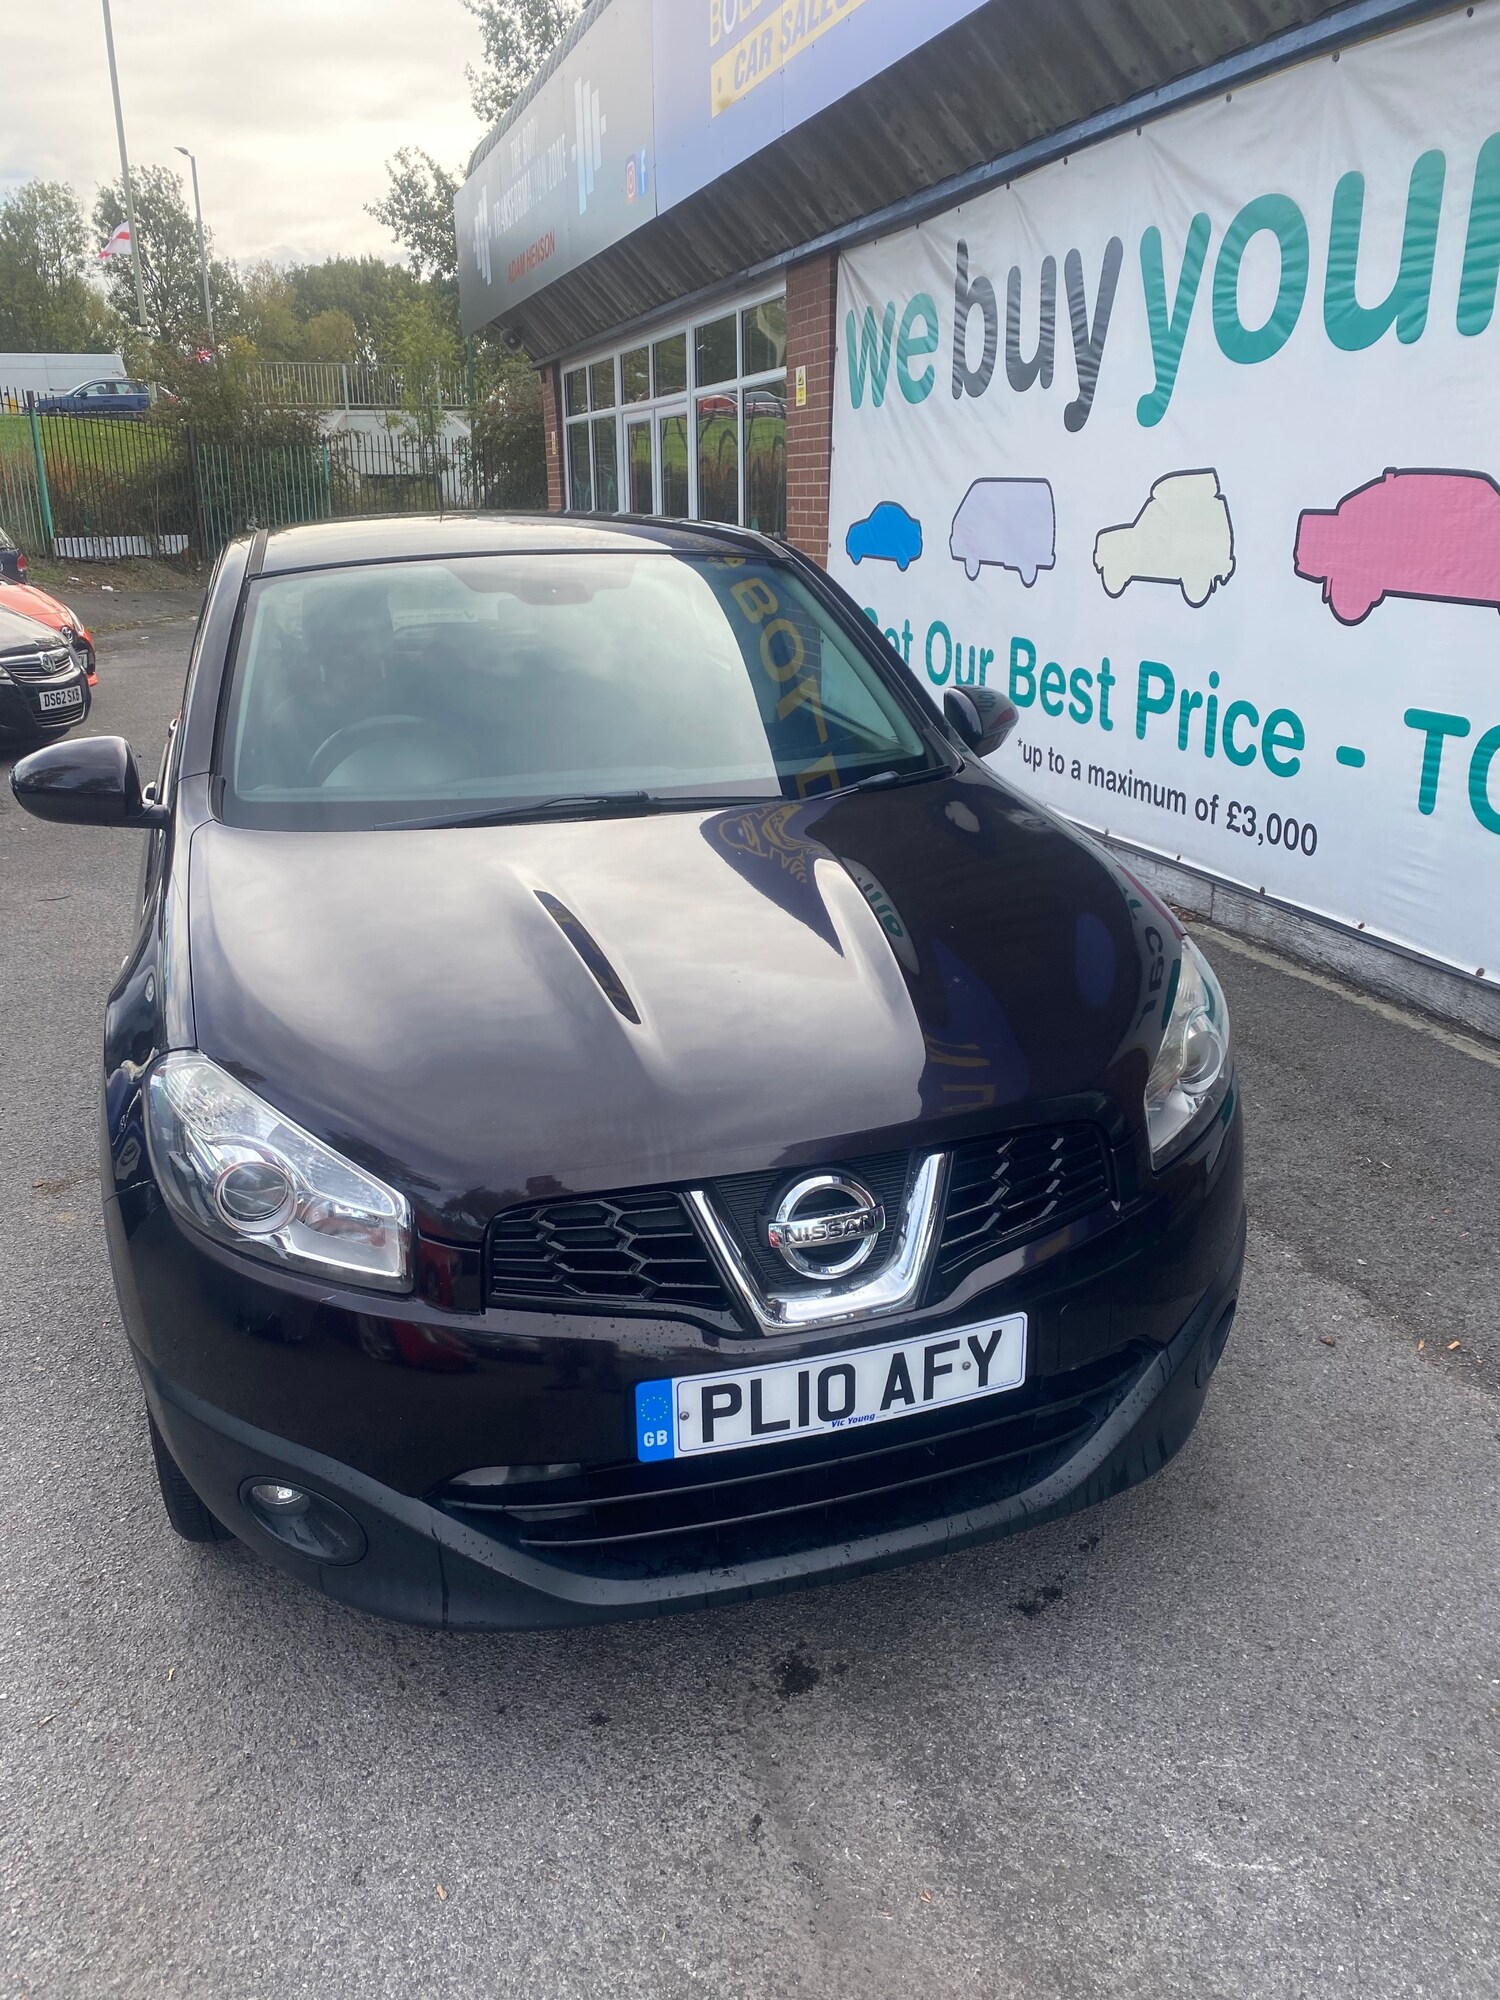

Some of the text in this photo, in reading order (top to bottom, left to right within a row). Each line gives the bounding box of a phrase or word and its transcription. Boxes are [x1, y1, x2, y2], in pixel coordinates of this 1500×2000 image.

[734, 0, 850, 90] CAR SALE
[510, 132, 522, 178] THE
[493, 133, 567, 240] TRANSFORMATION ZONE
[507, 228, 556, 285] ADAM HENSON
[43, 690, 67, 707] DS62
[925, 620, 994, 687] Our
[1009, 636, 1115, 731] Best
[1135, 660, 1306, 778] Price
[1047, 745, 1065, 775] to
[1070, 759, 1081, 780] a
[1088, 763, 1186, 815] maximum
[1195, 794, 1219, 824] of
[1226, 800, 1318, 856] £3,000
[783, 1213, 878, 1246] NISSAN
[701, 1329, 1003, 1443] PL10 AFY
[642, 1429, 668, 1448] GB
[830, 1418, 845, 1429] Vic
[847, 1413, 876, 1426] Young
